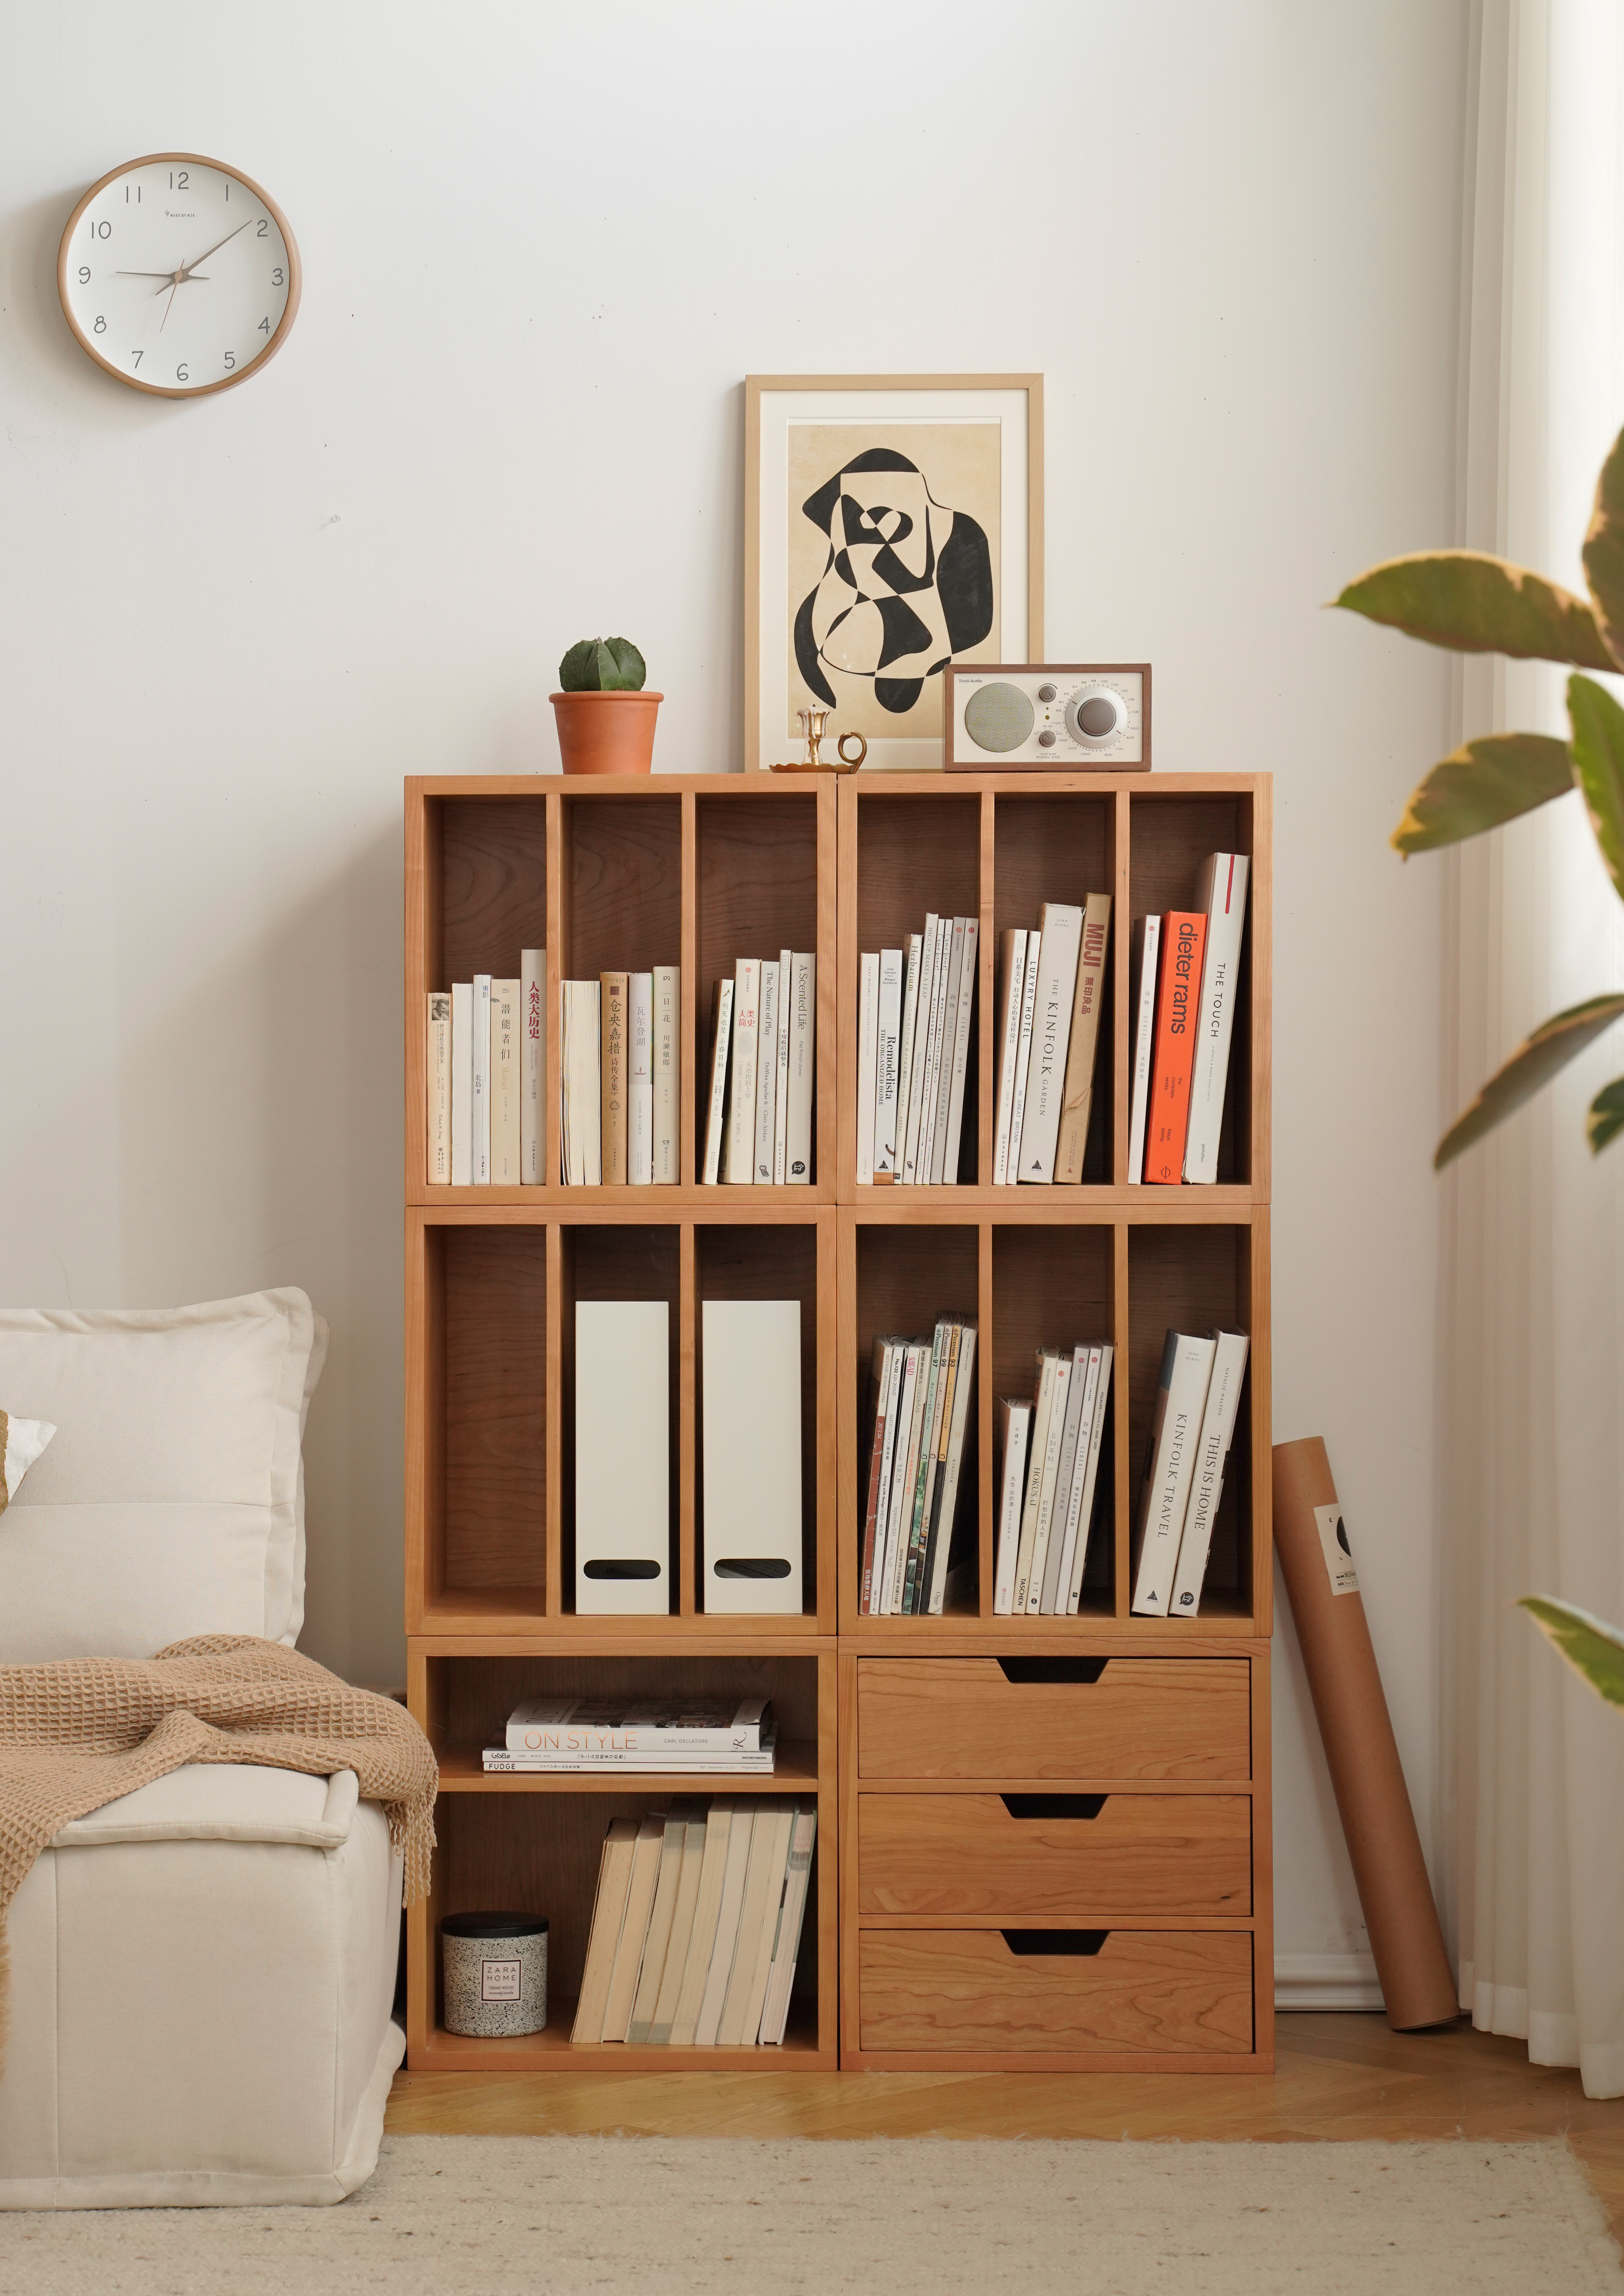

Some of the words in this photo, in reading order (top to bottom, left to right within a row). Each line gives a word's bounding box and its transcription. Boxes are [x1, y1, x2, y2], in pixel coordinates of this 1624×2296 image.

[126, 186, 141, 203] 11
[169, 172, 189, 190] 12
[92, 221, 112, 239] 10
[257, 220, 268, 237] 2
[78, 266, 91, 284] 9
[272, 268, 284, 286] 3
[94, 316, 107, 333] 8
[258, 316, 270, 334] 4
[132, 350, 144, 368] 7
[176, 363, 188, 381] 6
[224, 351, 235, 369] 5
[1083, 923, 1105, 967] MUJI
[1176, 923, 1198, 980] dieter
[908, 946, 918, 991] Herbarium
[1027, 961, 1037, 1001] LUXYRY
[1216, 963, 1225, 986] THE
[482, 985, 489, 998] 重影
[798, 973, 808, 1011] Scented
[949, 995, 956, 1008] 谷物
[962, 992, 968, 1006] 谷物
[1081, 977, 1095, 1014] 無印良品
[1144, 991, 1150, 1006] 谷物
[528, 981, 540, 1039] 人类大历史
[662, 993, 671, 1022] 一日一花
[720, 1003, 728, 1034] 明天也是
[798, 1014, 807, 1030] Life
[1010, 987, 1019, 1044] 打动人心的家这样设计
[1023, 1007, 1032, 1038] HOTEL
[1171, 984, 1189, 1034] rams
[1211, 993, 1223, 1037] TOUCH
[501, 1003, 511, 1061] 潜能者们
[607, 999, 622, 1055] 仓央嘉措
[636, 1007, 645, 1046] 瓦尔登湖
[1042, 1002, 1058, 1075] KINFOLK
[717, 1038, 725, 1069] 小春日和
[885, 1036, 896, 1100] Remodelista
[475, 1075, 481, 1087] 北岛
[1040, 1080, 1048, 1116] GARDEN
[1068, 1424, 1075, 1438] 谷物
[1082, 1422, 1088, 1436] 谷物
[1048, 1433, 1056, 1462] 日和手帖
[1168, 1413, 1187, 1480] KINFOLK
[1206, 1435, 1220, 1467] THIS
[1030, 1468, 1040, 1506] HOKUSAI
[1203, 1471, 1214, 1483] IS
[1039, 1500, 1048, 1537] 打包你的人生
[1158, 1487, 1175, 1537] TRAVEL
[1195, 1487, 1211, 1530] HOME
[1018, 1578, 1026, 1605] TASCHEN
[525, 1732, 559, 1749] ON
[567, 1732, 637, 1749] STYLE
